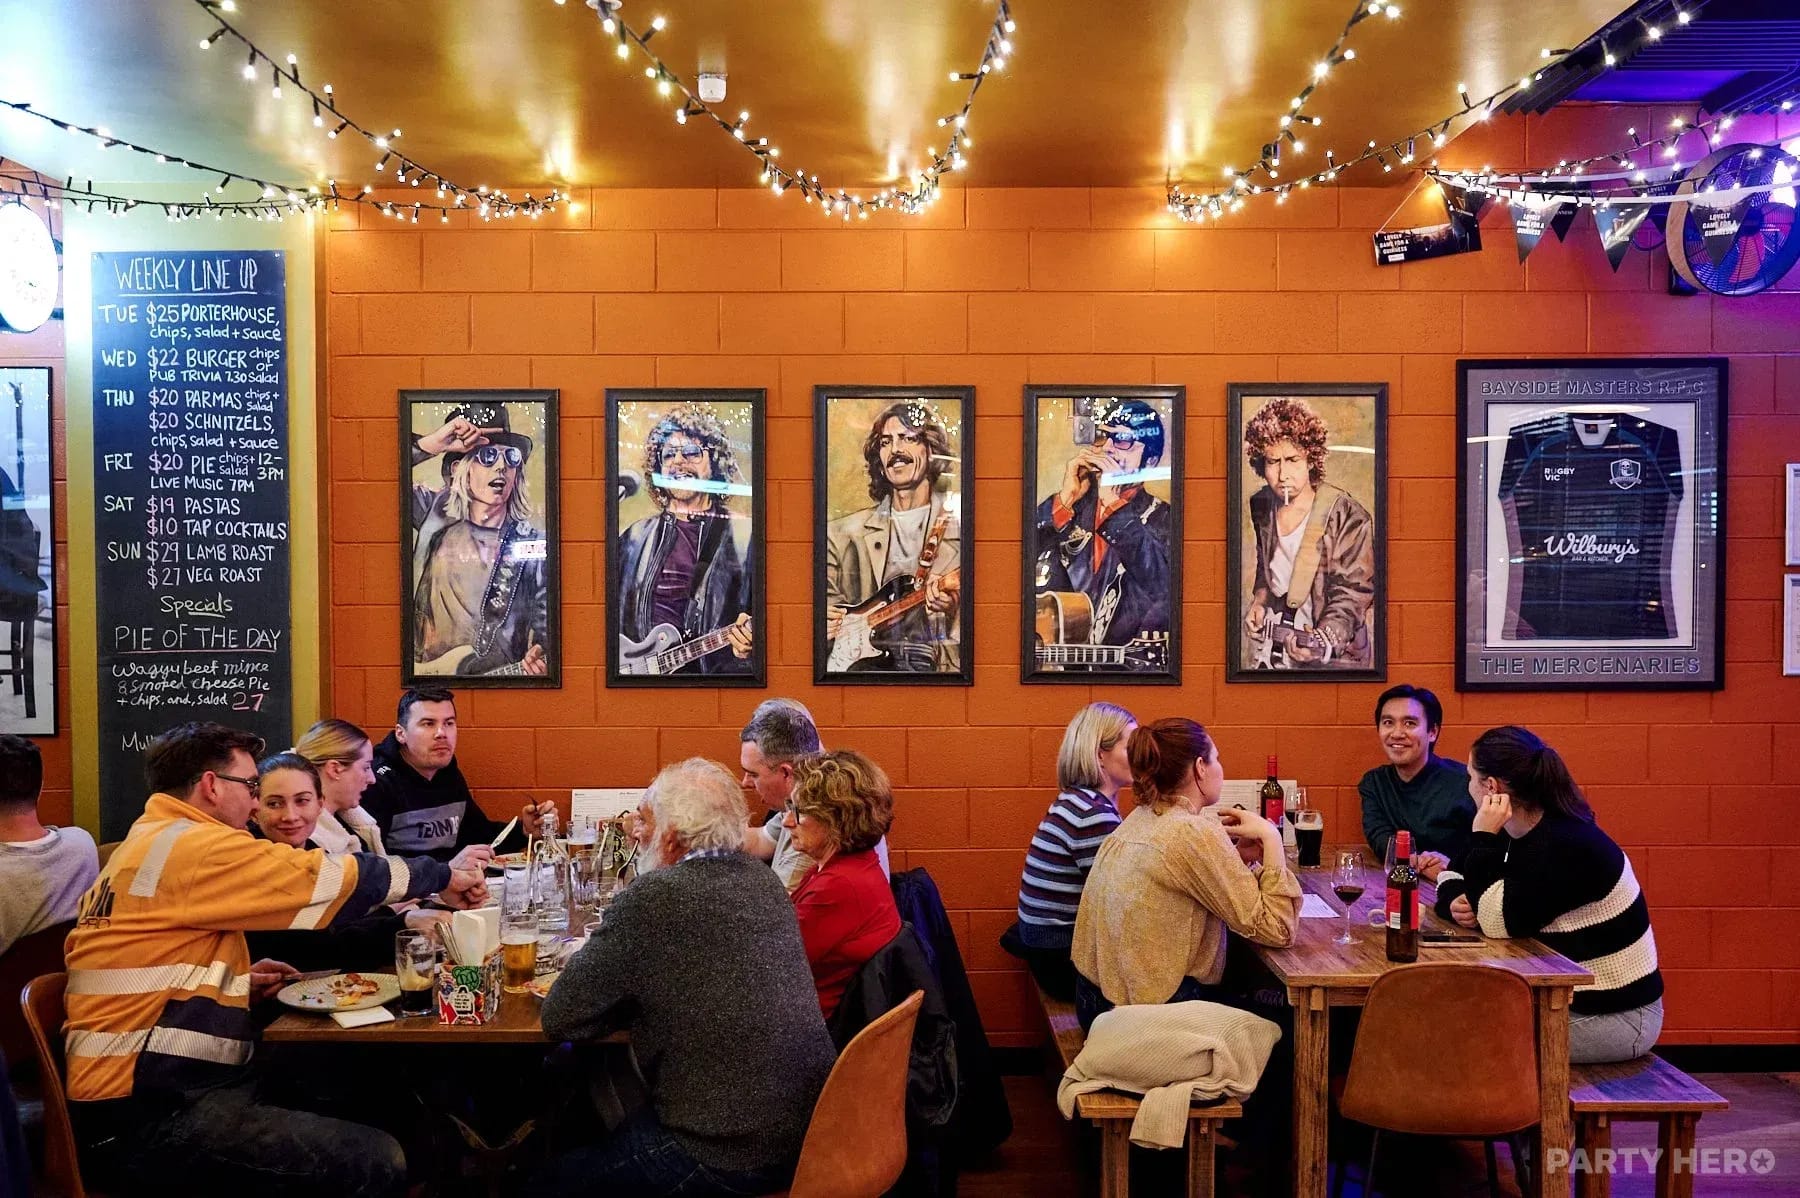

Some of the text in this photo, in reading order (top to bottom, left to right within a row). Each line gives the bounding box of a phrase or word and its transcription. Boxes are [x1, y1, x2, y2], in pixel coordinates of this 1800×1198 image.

[1702, 221, 1718, 230] GAME
[1709, 212, 1731, 221] LOVELY
[1384, 233, 1402, 241] LOVELY
[114, 256, 258, 291] WEEKLY LINE UP
[98, 301, 280, 327] TUE $25 PORTERHOUSE,
[101, 346, 280, 370] WED $22 BURGER chips
[256, 363, 273, 371] or
[149, 369, 176, 382] PUB
[180, 369, 222, 383] TRIVIA
[225, 371, 247, 383] 7.30
[1481, 380, 1560, 395] BAYSIDE
[1565, 380, 1653, 395] MASTERS
[103, 388, 135, 407] THU
[148, 387, 179, 408] $20
[185, 389, 243, 410] PARMAS
[245, 388, 271, 402] chips
[148, 409, 275, 435] $20 SCHNITZELS,
[104, 452, 133, 471] FRI
[148, 450, 183, 474] $20
[191, 455, 216, 474] PIE
[257, 467, 284, 480] 3PM
[151, 475, 255, 493] LIVE MUSIC 7PM
[104, 495, 241, 515] SAT $19 PASTAS
[147, 516, 287, 540] $10 TAP COCKTAILS
[107, 539, 275, 565] SUN $29 LAMB ROAST
[1543, 532, 1640, 564] Wilbury's
[186, 566, 213, 583] VEG
[220, 567, 263, 583] ROAST
[160, 592, 233, 618] Specials
[115, 623, 281, 651] PIE OF THE DAY
[183, 659, 219, 675] beef
[224, 659, 269, 676] mince
[1480, 657, 1700, 675] THE MERCENARIES
[249, 676, 271, 691] Pie
[232, 692, 264, 712] 27
